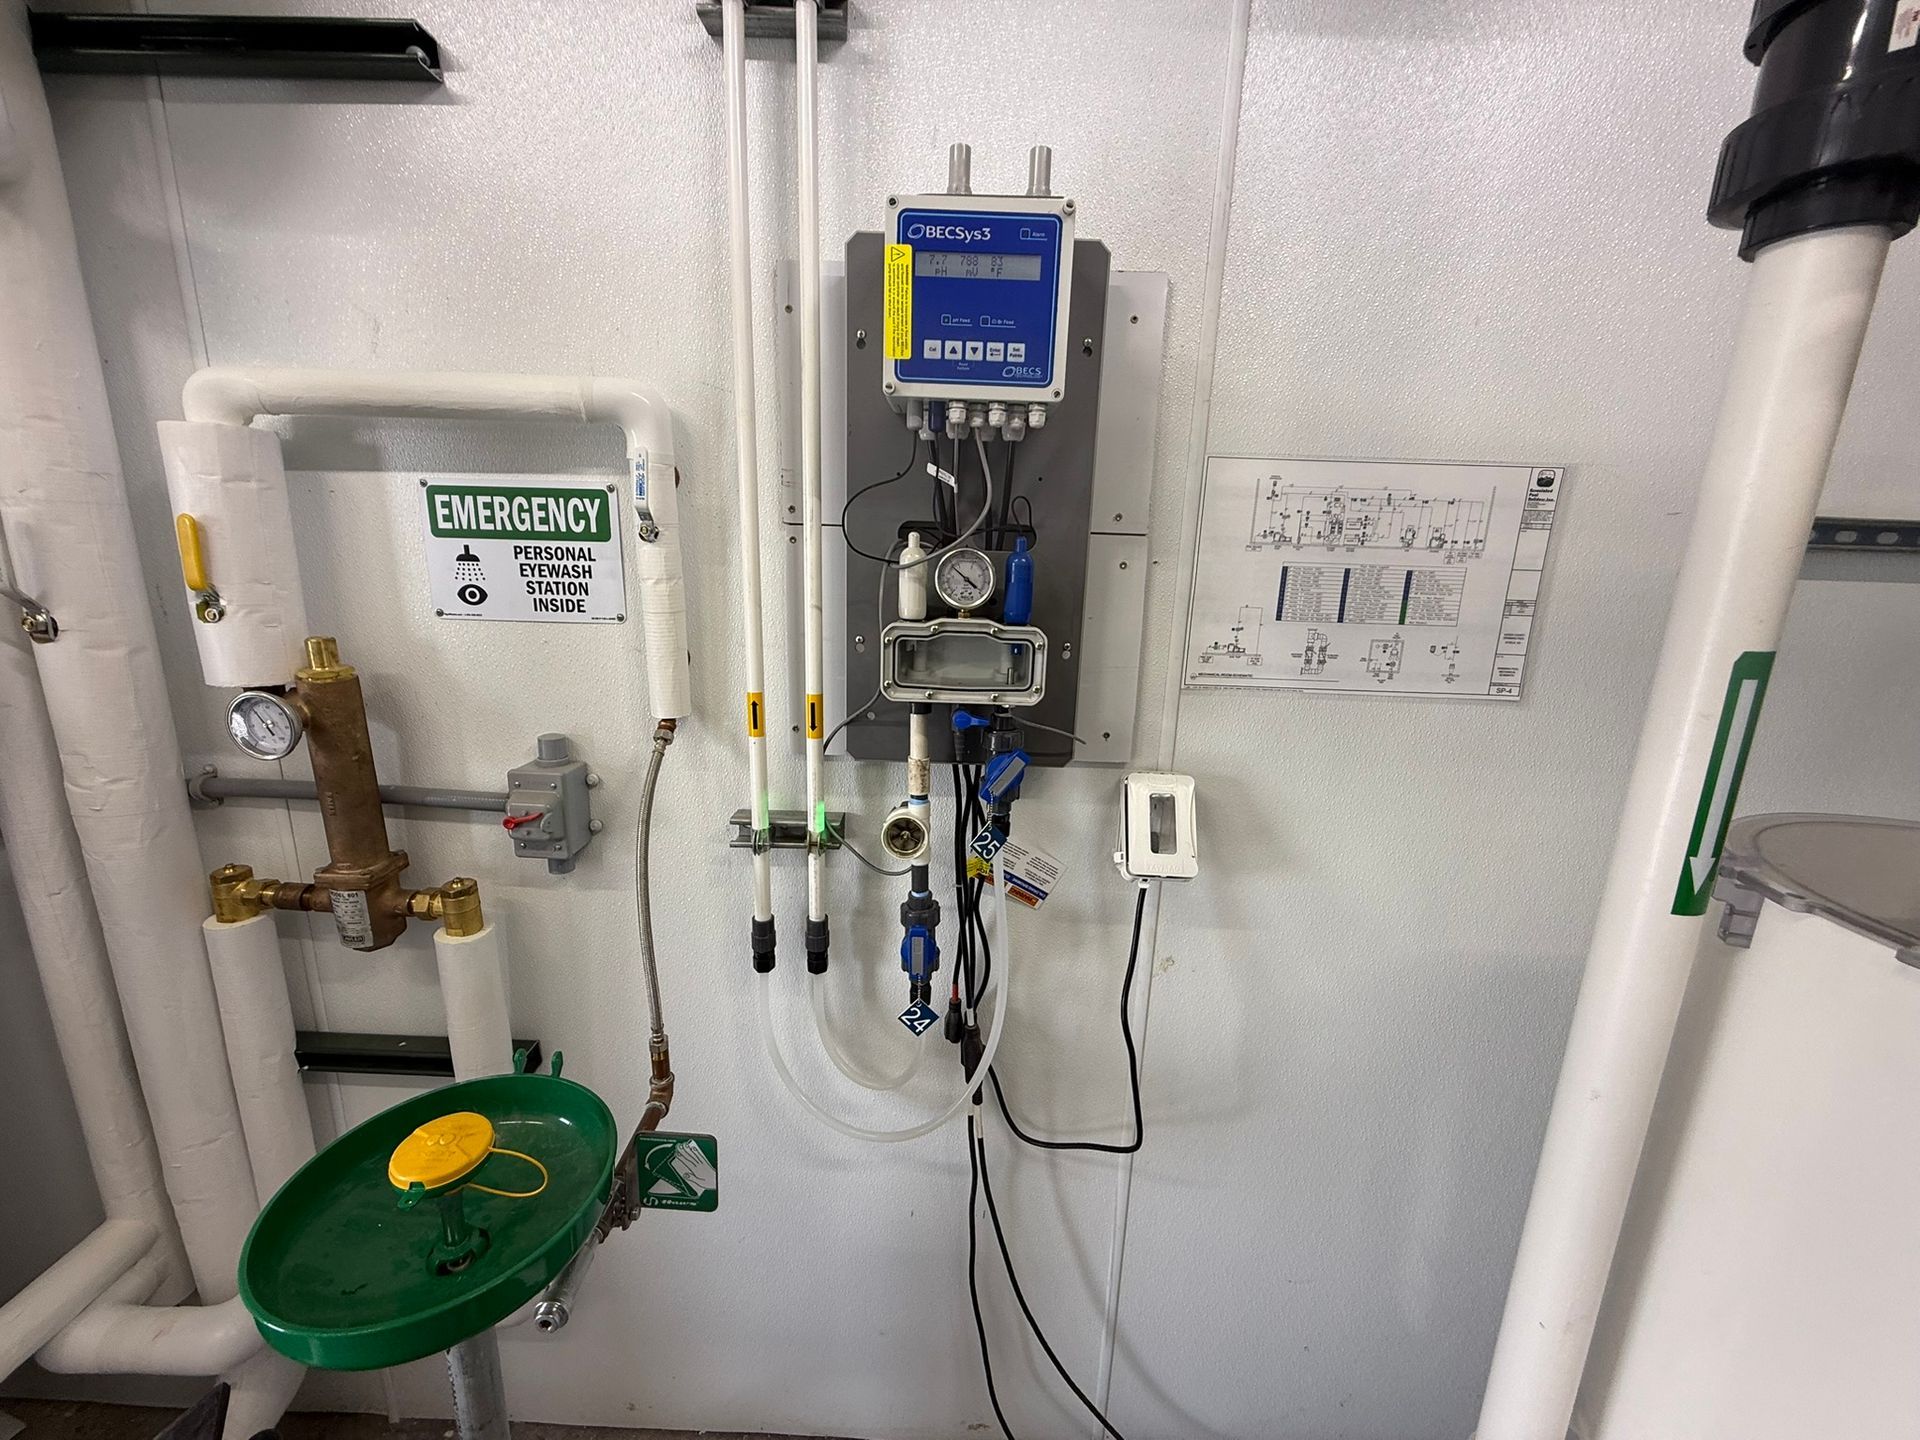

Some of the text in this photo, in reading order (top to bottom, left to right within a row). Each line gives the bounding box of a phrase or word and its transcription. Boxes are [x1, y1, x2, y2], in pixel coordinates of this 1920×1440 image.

[926, 225, 991, 243] BECSys3
[929, 254, 1004, 267] 7.7 788 83
[934, 266, 948, 276] pH
[1016, 366, 1042, 375] BECS
[434, 494, 601, 534] EMERGENCY
[513, 545, 597, 562] PERSONAL
[519, 563, 593, 579] EYEWASH
[526, 580, 589, 596] STATION
[533, 598, 587, 614] INSIDE
[972, 832, 1001, 859] 25
[900, 1007, 930, 1033] 24
